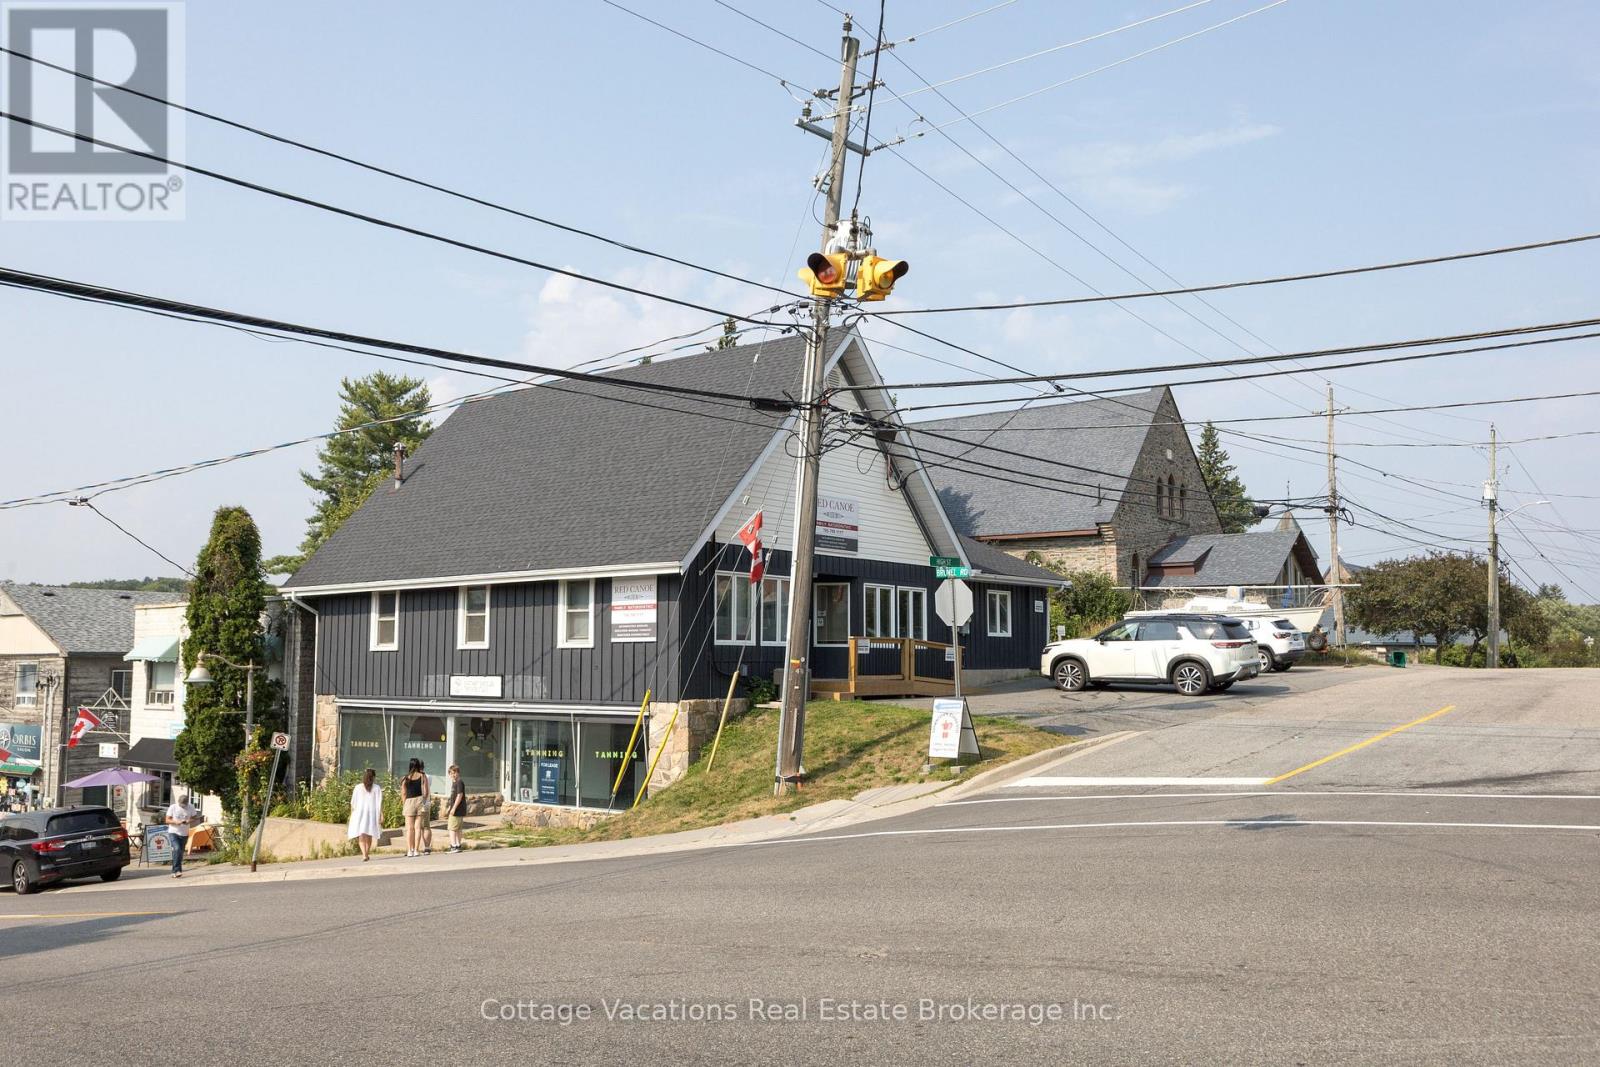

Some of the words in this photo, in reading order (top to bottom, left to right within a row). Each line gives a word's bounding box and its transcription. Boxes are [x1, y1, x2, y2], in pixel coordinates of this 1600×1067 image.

[817, 498, 828, 508] ED
[829, 500, 855, 512] CANOE
[959, 568, 968, 576] RD
[614, 585, 629, 593] RED
[630, 584, 655, 593] CANOE
[12, 734, 37, 746] ORBIS
[351, 740, 379, 748] TANNING
[525, 749, 564, 758] TANNING
